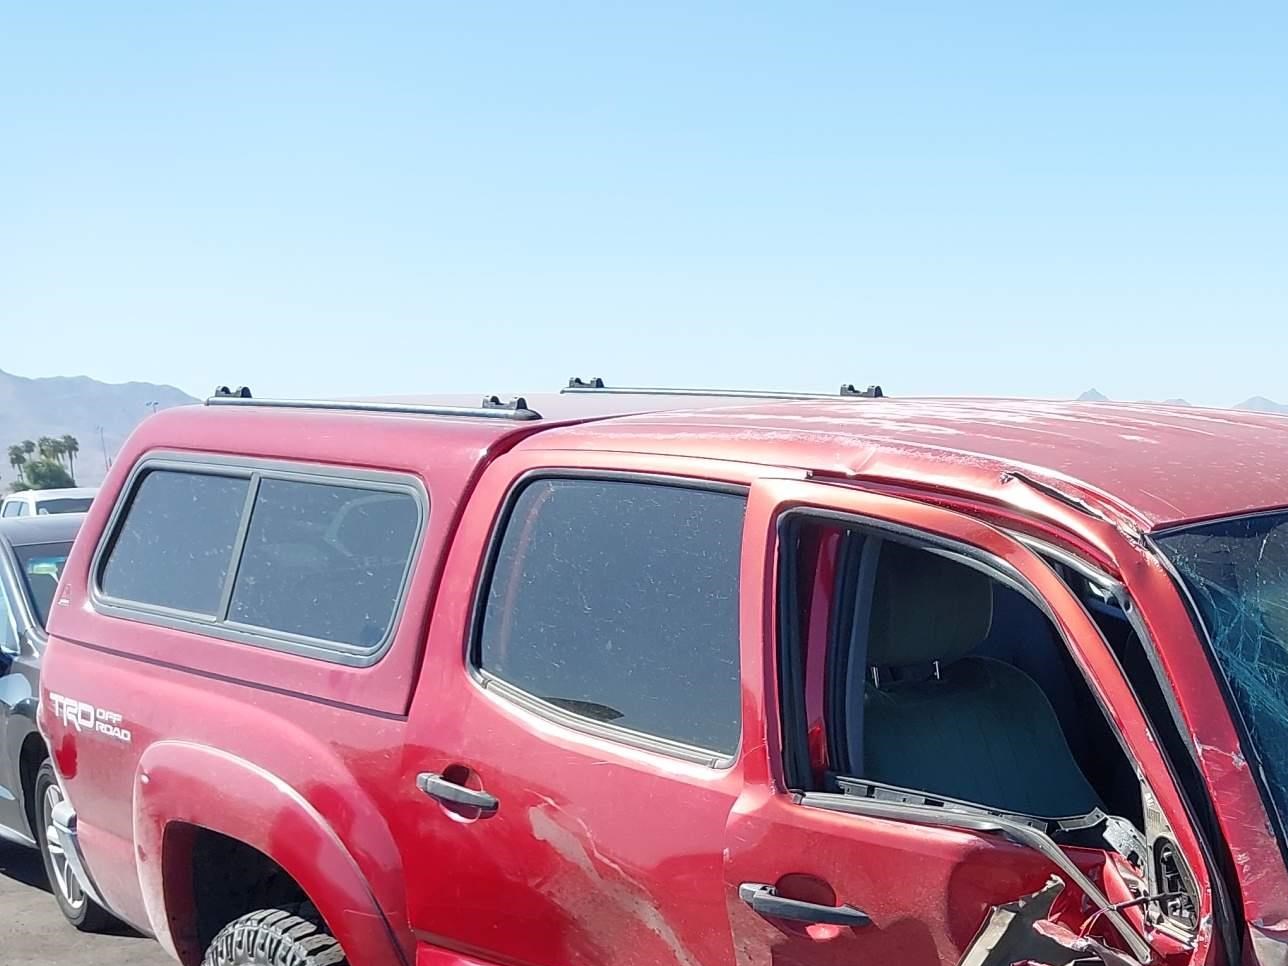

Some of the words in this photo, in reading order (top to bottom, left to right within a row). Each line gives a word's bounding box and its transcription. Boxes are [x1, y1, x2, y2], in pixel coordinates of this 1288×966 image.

[49, 691, 95, 731] TRD
[96, 708, 122, 723] OFF
[95, 720, 131, 741] ROAD
